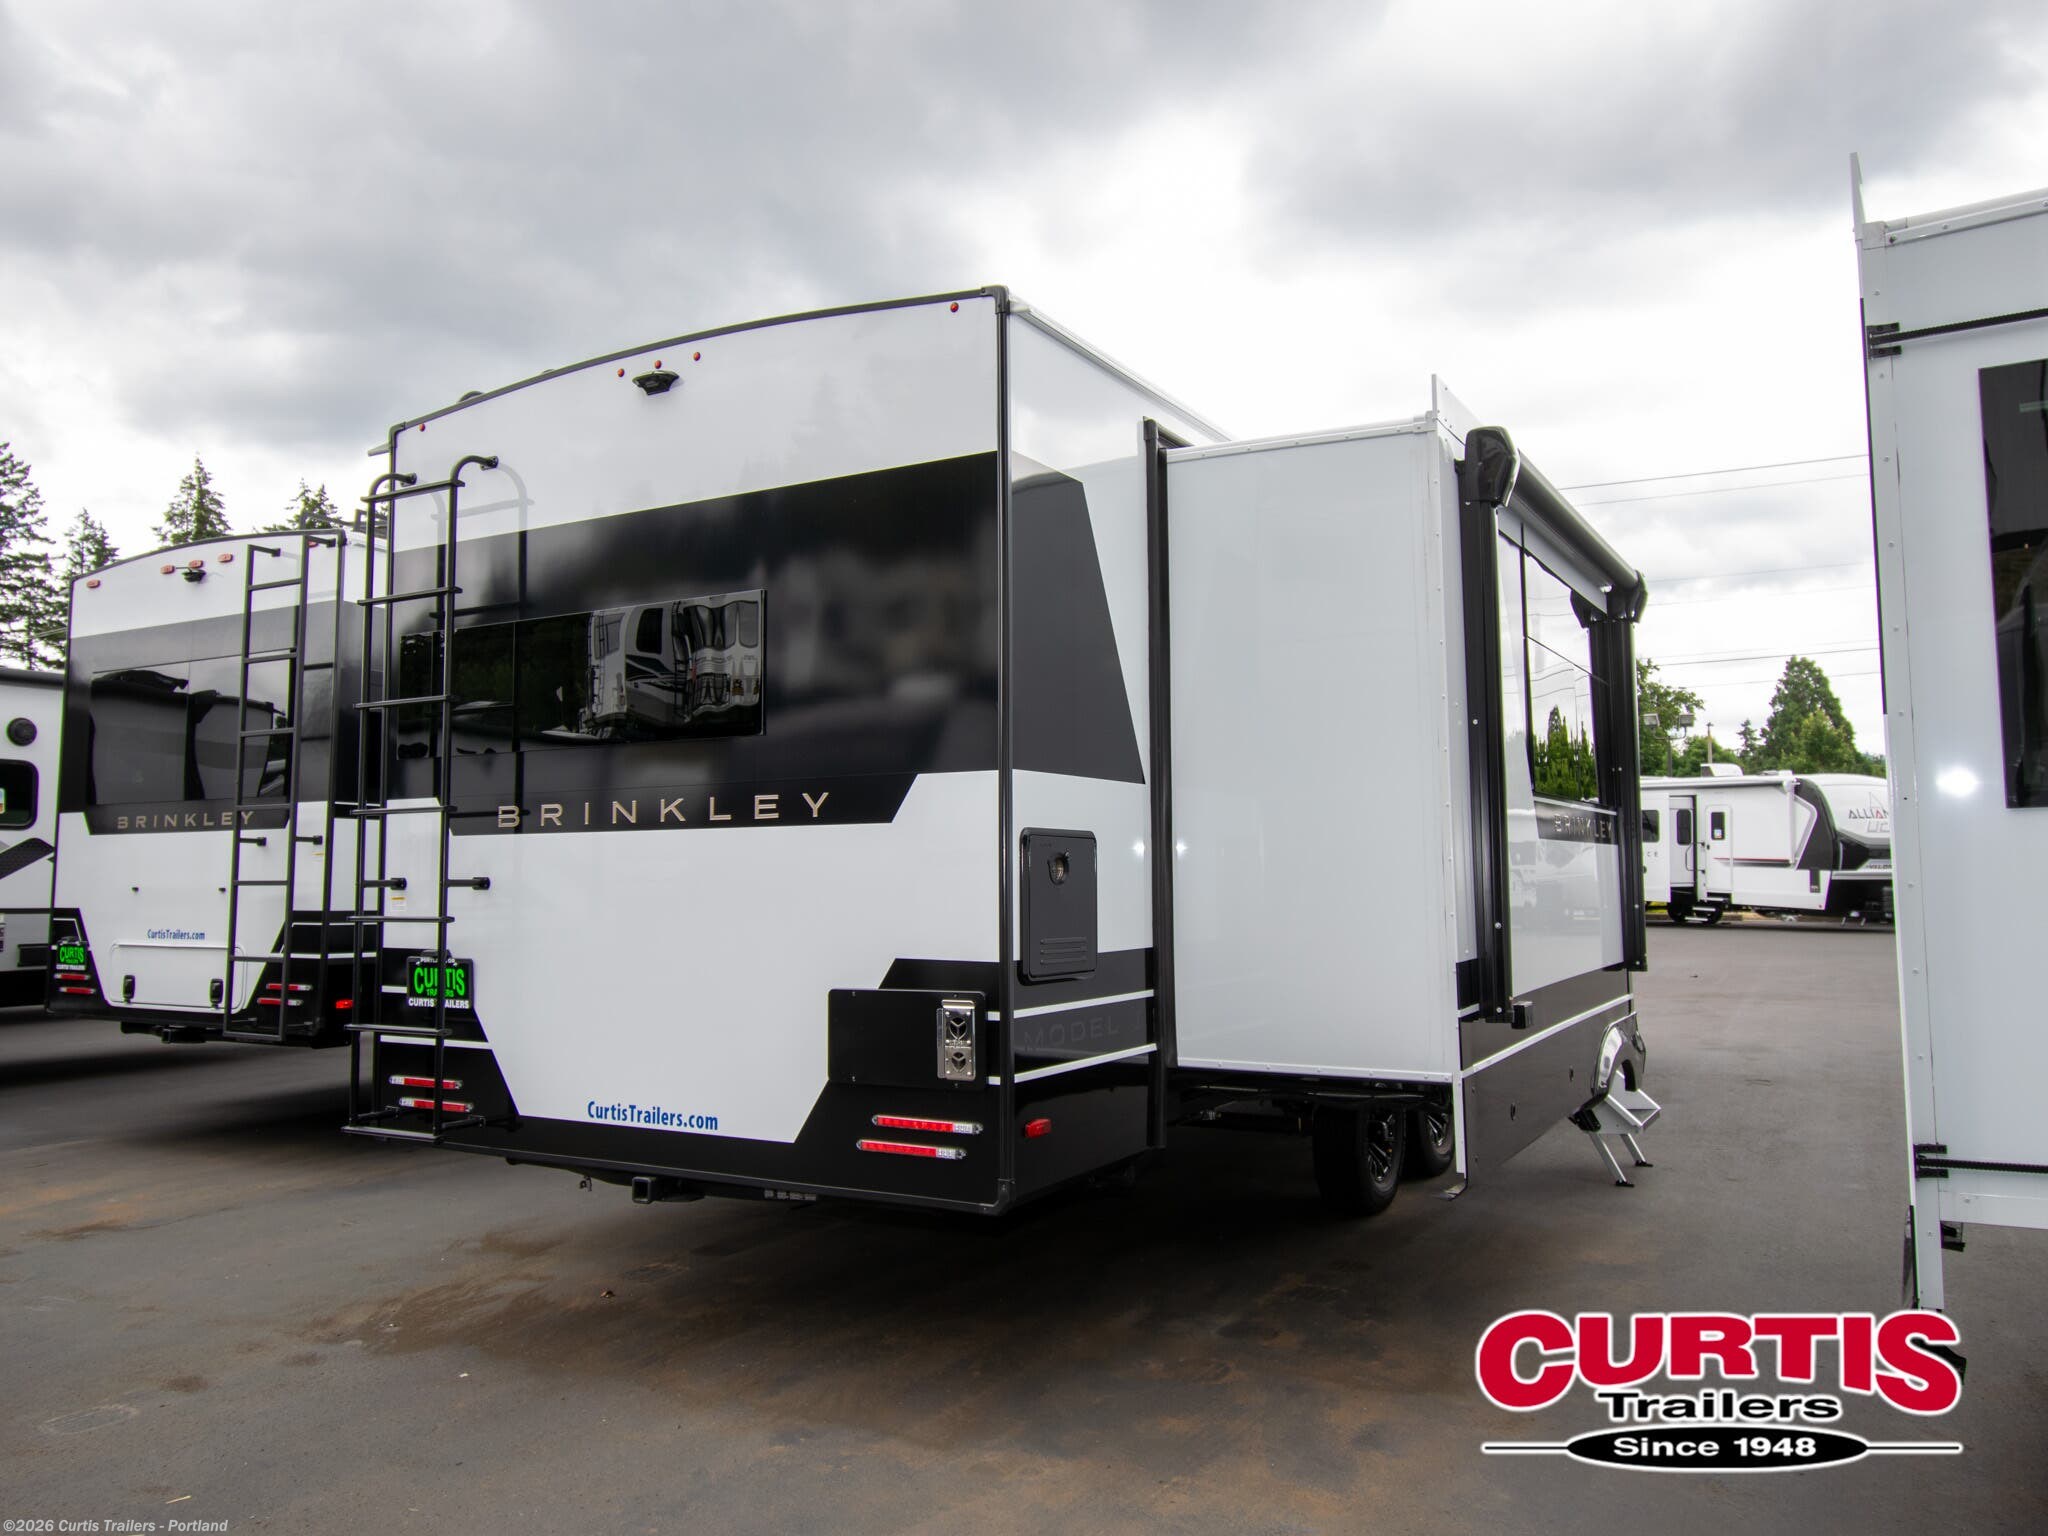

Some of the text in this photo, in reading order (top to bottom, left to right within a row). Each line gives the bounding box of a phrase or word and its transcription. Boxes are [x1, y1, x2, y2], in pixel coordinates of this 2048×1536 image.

[498, 791, 829, 828] BRINKLEY
[117, 811, 254, 829] BRINKLEY
[147, 929, 206, 940] CurtisTrailers.com
[59, 946, 84, 963] CURTIS
[408, 998, 435, 1008] CURTIS
[1024, 1015, 1120, 1050] MODEL
[587, 1100, 719, 1131] CurtisTrailers.com
